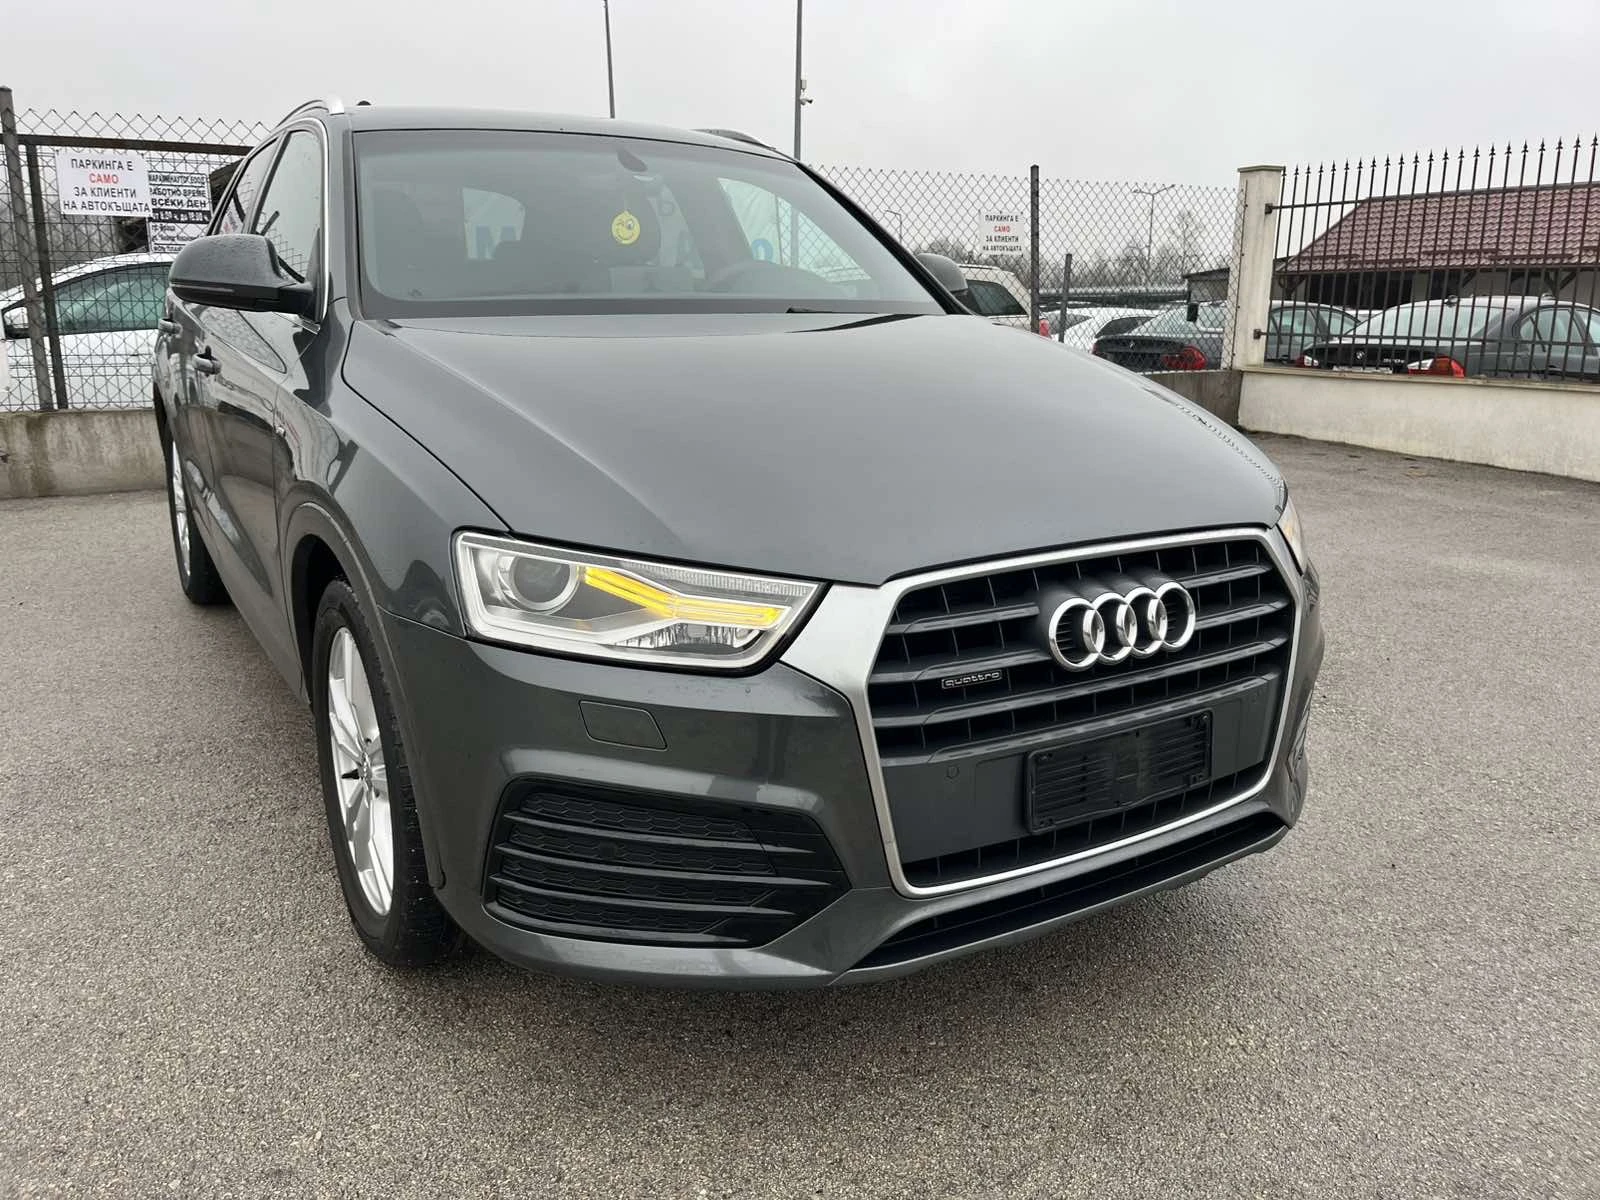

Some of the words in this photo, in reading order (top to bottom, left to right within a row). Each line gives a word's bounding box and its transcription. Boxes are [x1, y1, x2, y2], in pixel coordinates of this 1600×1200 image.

[71, 158, 125, 171] ПАРКИНГА
[127, 160, 133, 171] Е
[89, 173, 119, 184] САМО
[73, 186, 88, 197] ЗА
[90, 187, 136, 198] КЛИЕНТИ
[63, 200, 78, 210] НА
[80, 201, 151, 213] АВТОКЪЩАТА
[151, 198, 184, 208] ВСЕКИ
[186, 199, 206, 209] ДЕН
[985, 214, 1014, 222] ПАРКИНГА
[994, 225, 1011, 233] САМО
[944, 672, 1000, 687] quattro
